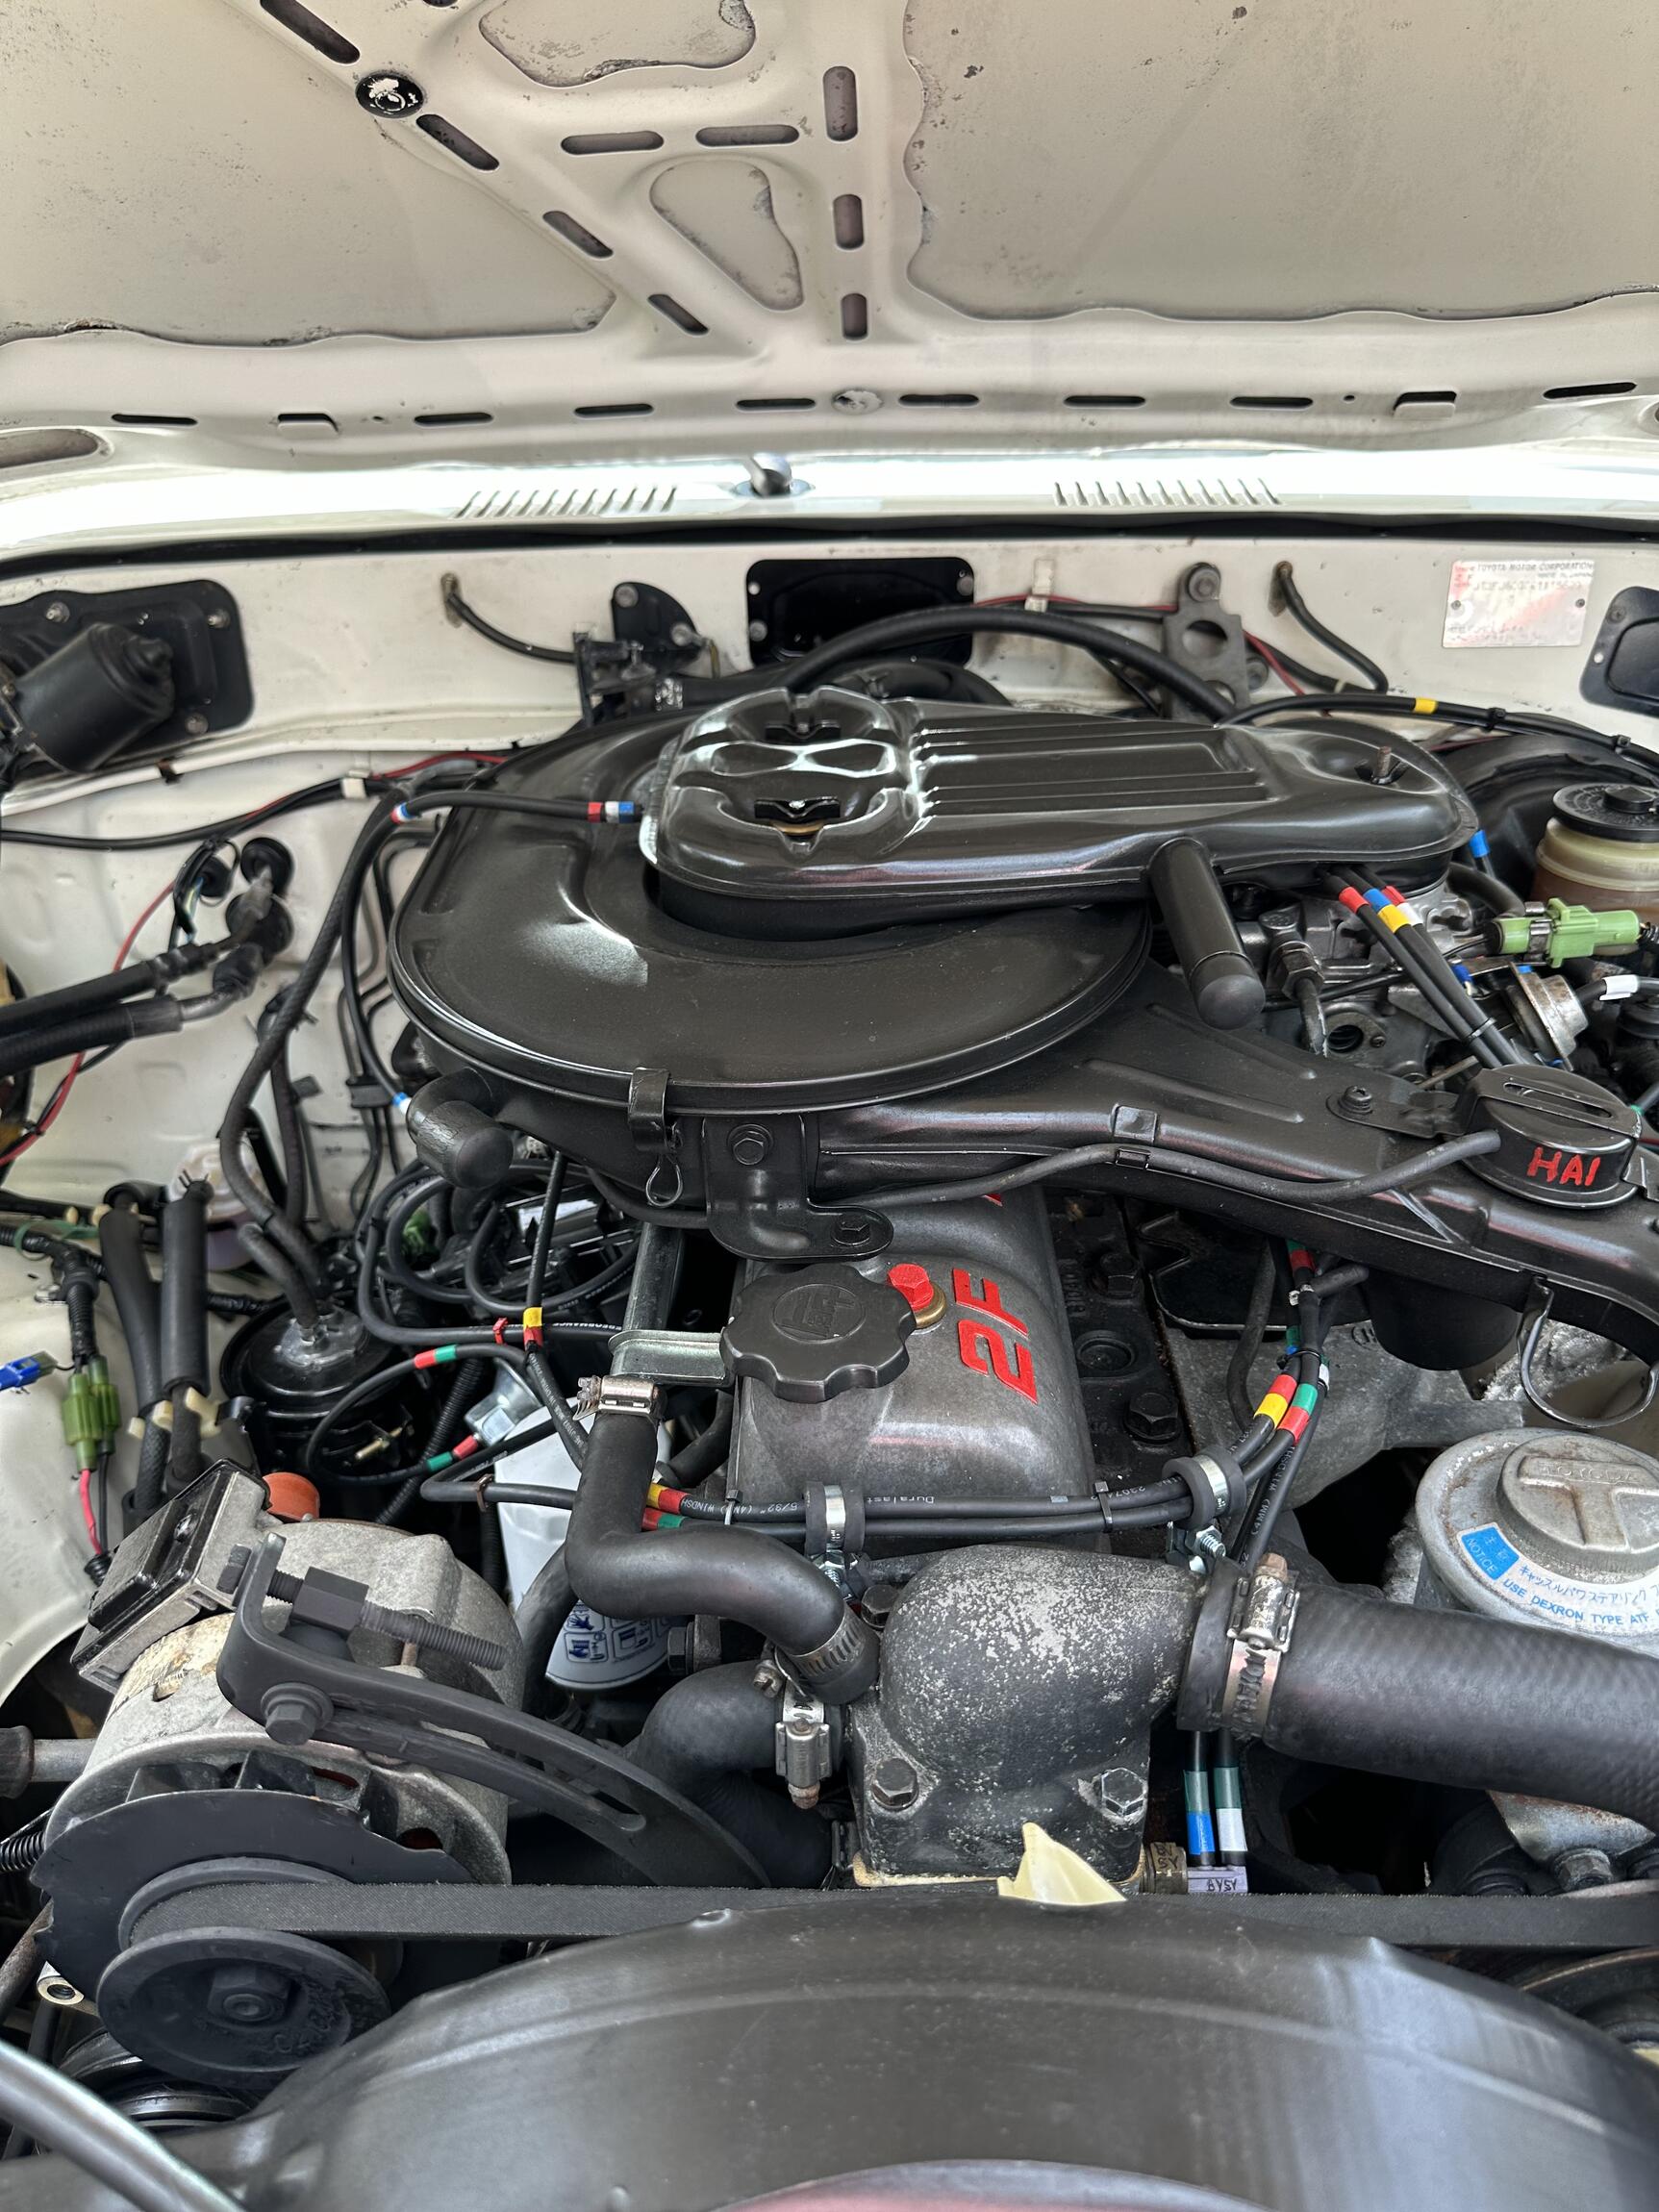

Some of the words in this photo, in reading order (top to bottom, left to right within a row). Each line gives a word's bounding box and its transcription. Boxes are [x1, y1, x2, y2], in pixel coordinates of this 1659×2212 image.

[1526, 1146, 1601, 1186] HAI
[951, 1268, 1038, 1405] 2F
[867, 1496, 935, 1504] Duralast
[1467, 1538, 1498, 1572] NOTICE
[1503, 1578, 1527, 1597] USE
[1531, 1596, 1583, 1621] DEXRON
[1591, 1614, 1624, 1625] TYPE
